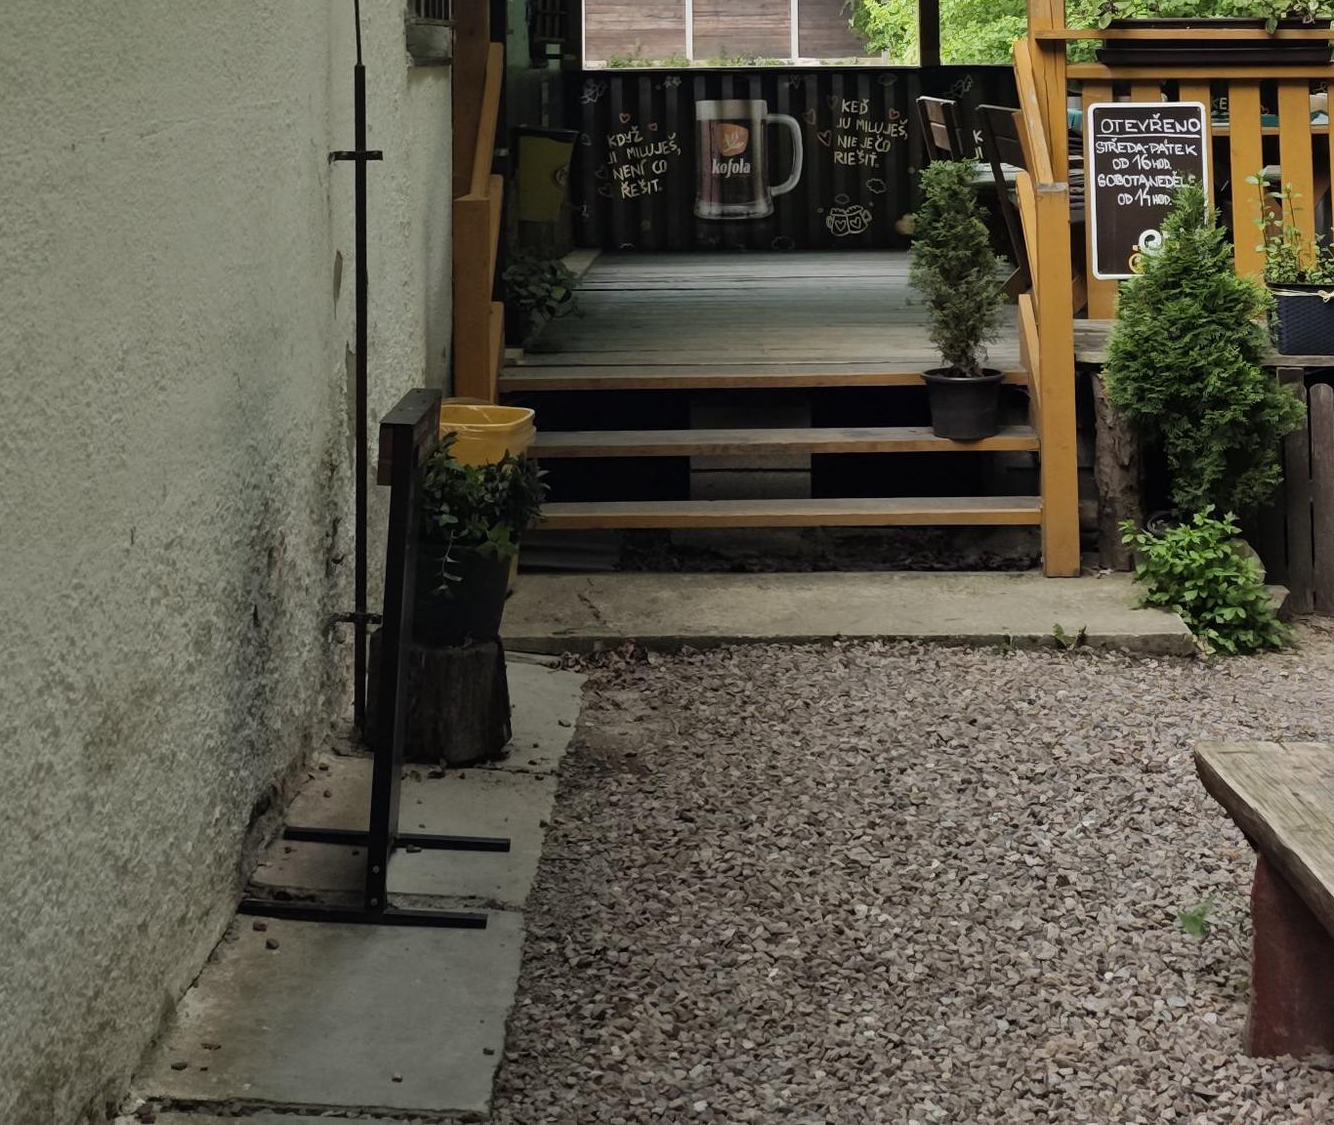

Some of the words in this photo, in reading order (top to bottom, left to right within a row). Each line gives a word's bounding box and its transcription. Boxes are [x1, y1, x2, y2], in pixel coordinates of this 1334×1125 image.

[841, 98, 869, 115] KEĎ
[836, 117, 851, 129] JU
[1100, 113, 1201, 133] OTEVŘENO
[607, 125, 643, 149] KDYŽ
[837, 135, 858, 149] NIE
[607, 152, 618, 165] JI
[1112, 158, 1130, 170] OD
[1132, 154, 1152, 170] 16
[613, 159, 646, 181] NENÍ
[652, 159, 668, 175] CO
[712, 158, 751, 179] kofola
[1117, 193, 1133, 206] OD
